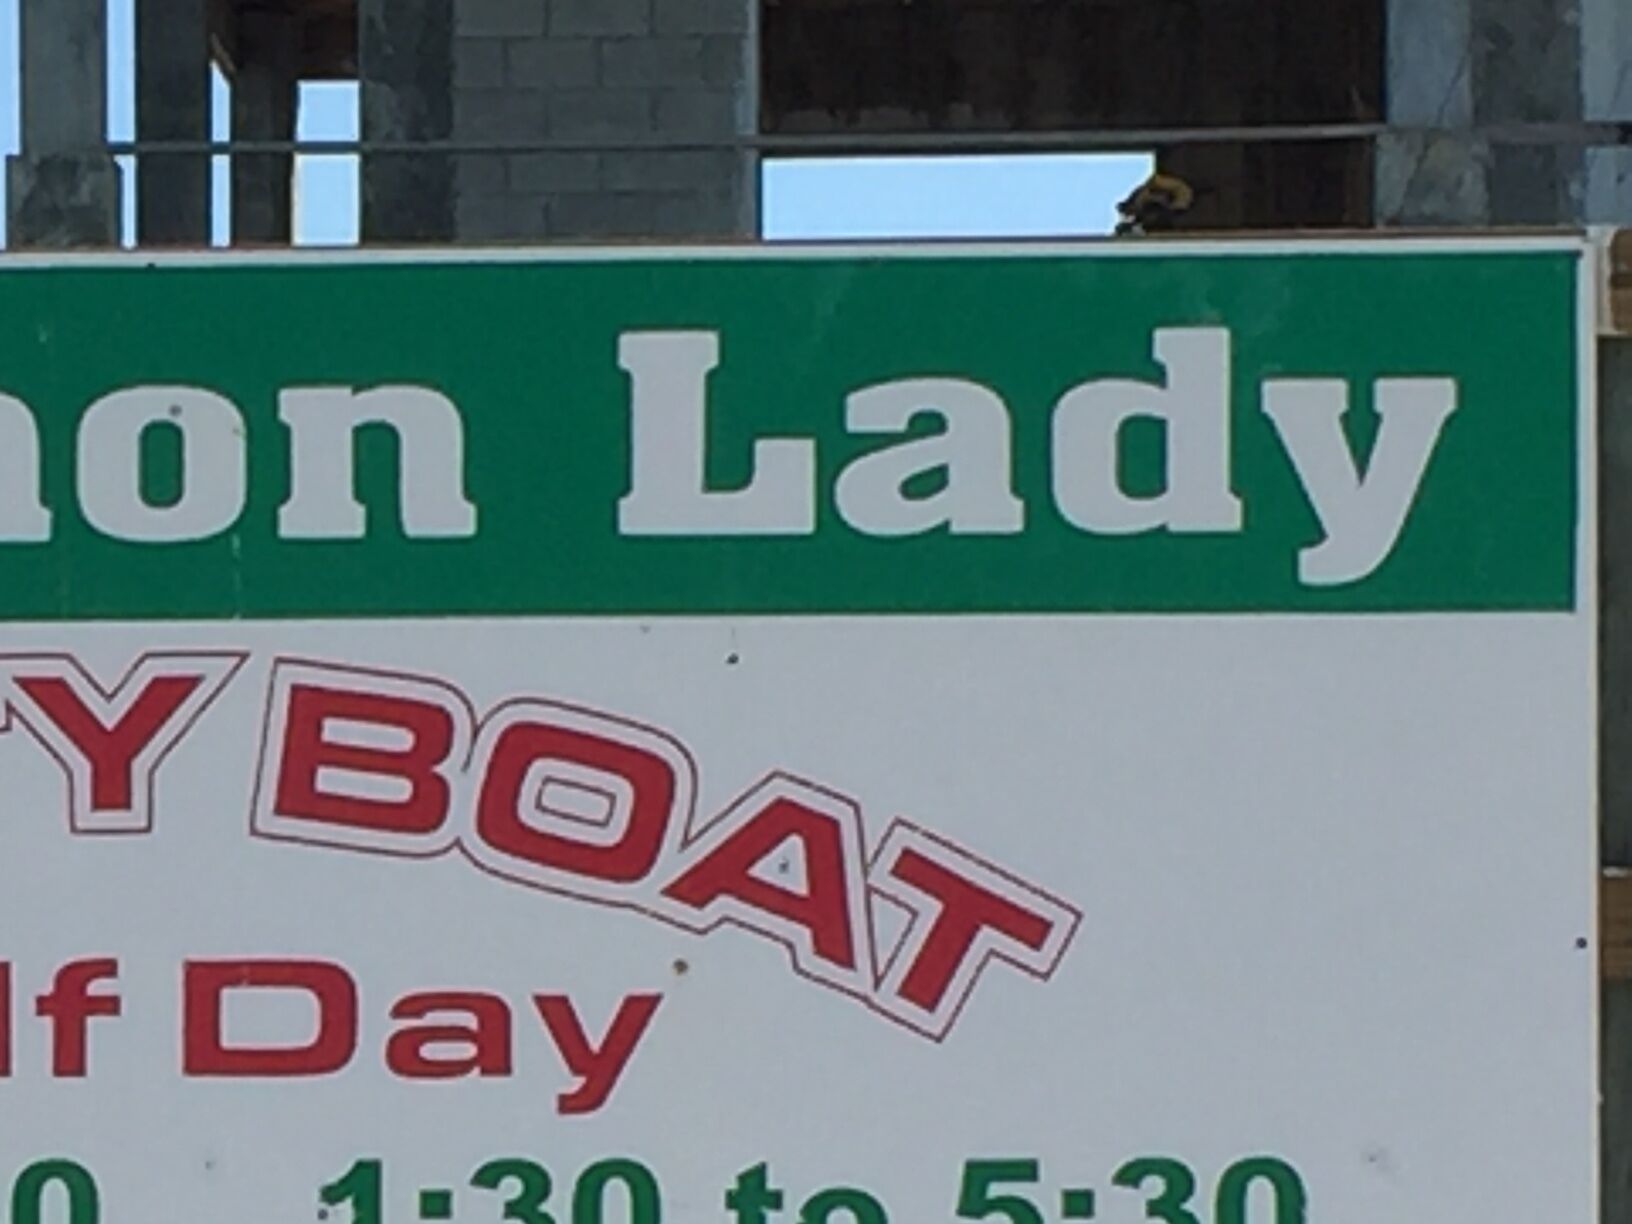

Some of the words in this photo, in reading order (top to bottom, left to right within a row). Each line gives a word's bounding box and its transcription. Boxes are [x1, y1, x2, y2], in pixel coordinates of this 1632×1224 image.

[618, 326, 1457, 584] Lady
[254, 662, 1080, 1038] BOAT
[183, 960, 660, 1113] Day
